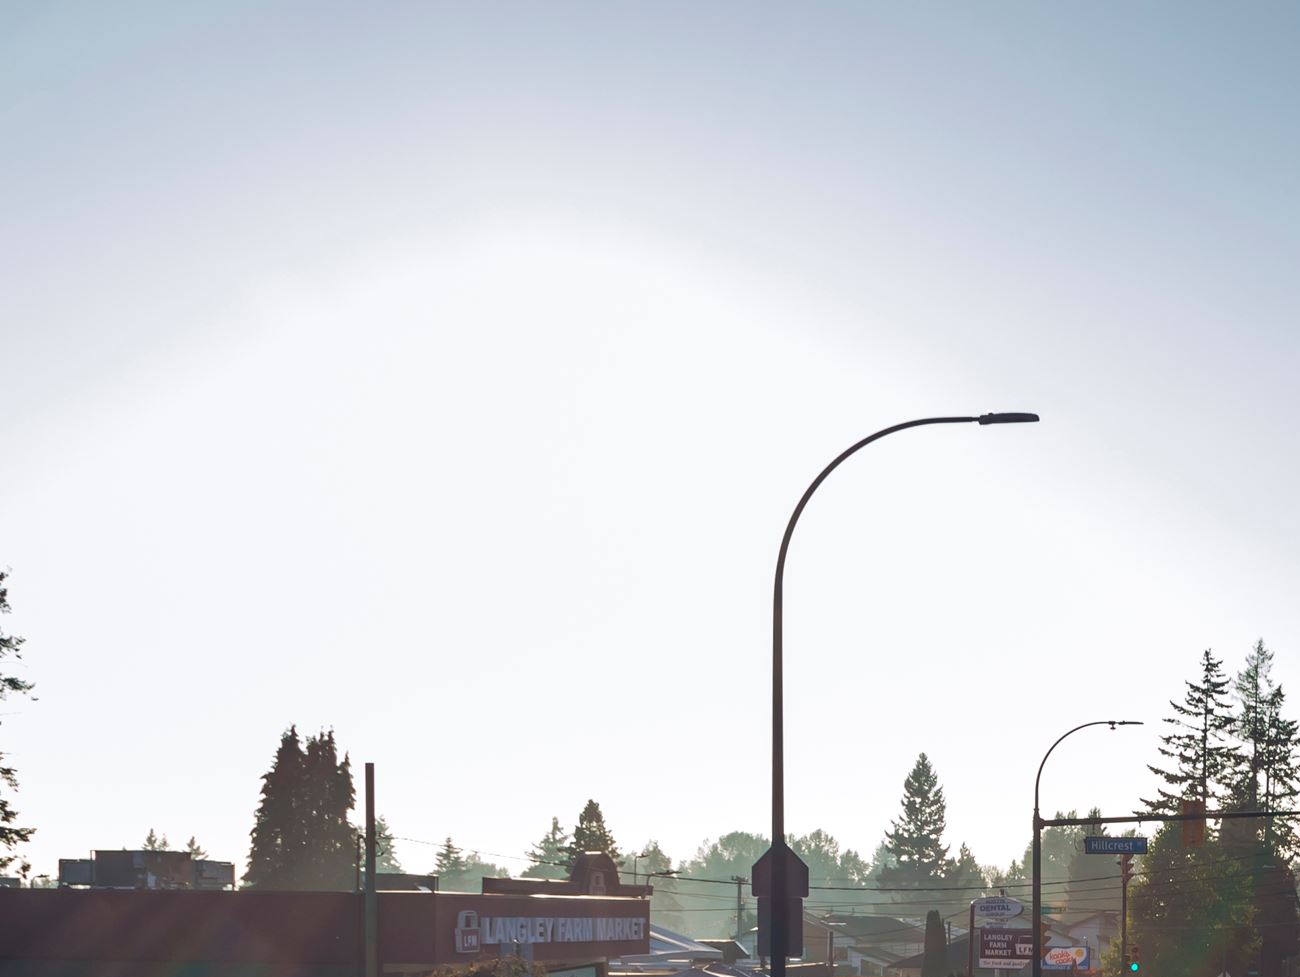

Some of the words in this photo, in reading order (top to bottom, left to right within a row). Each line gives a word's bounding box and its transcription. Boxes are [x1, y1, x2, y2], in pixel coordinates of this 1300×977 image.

[1091, 840, 1133, 850] Hillcrest
[482, 917, 554, 944] LANGLEY
[558, 917, 592, 942] FARM
[596, 917, 645, 940] MARKET
